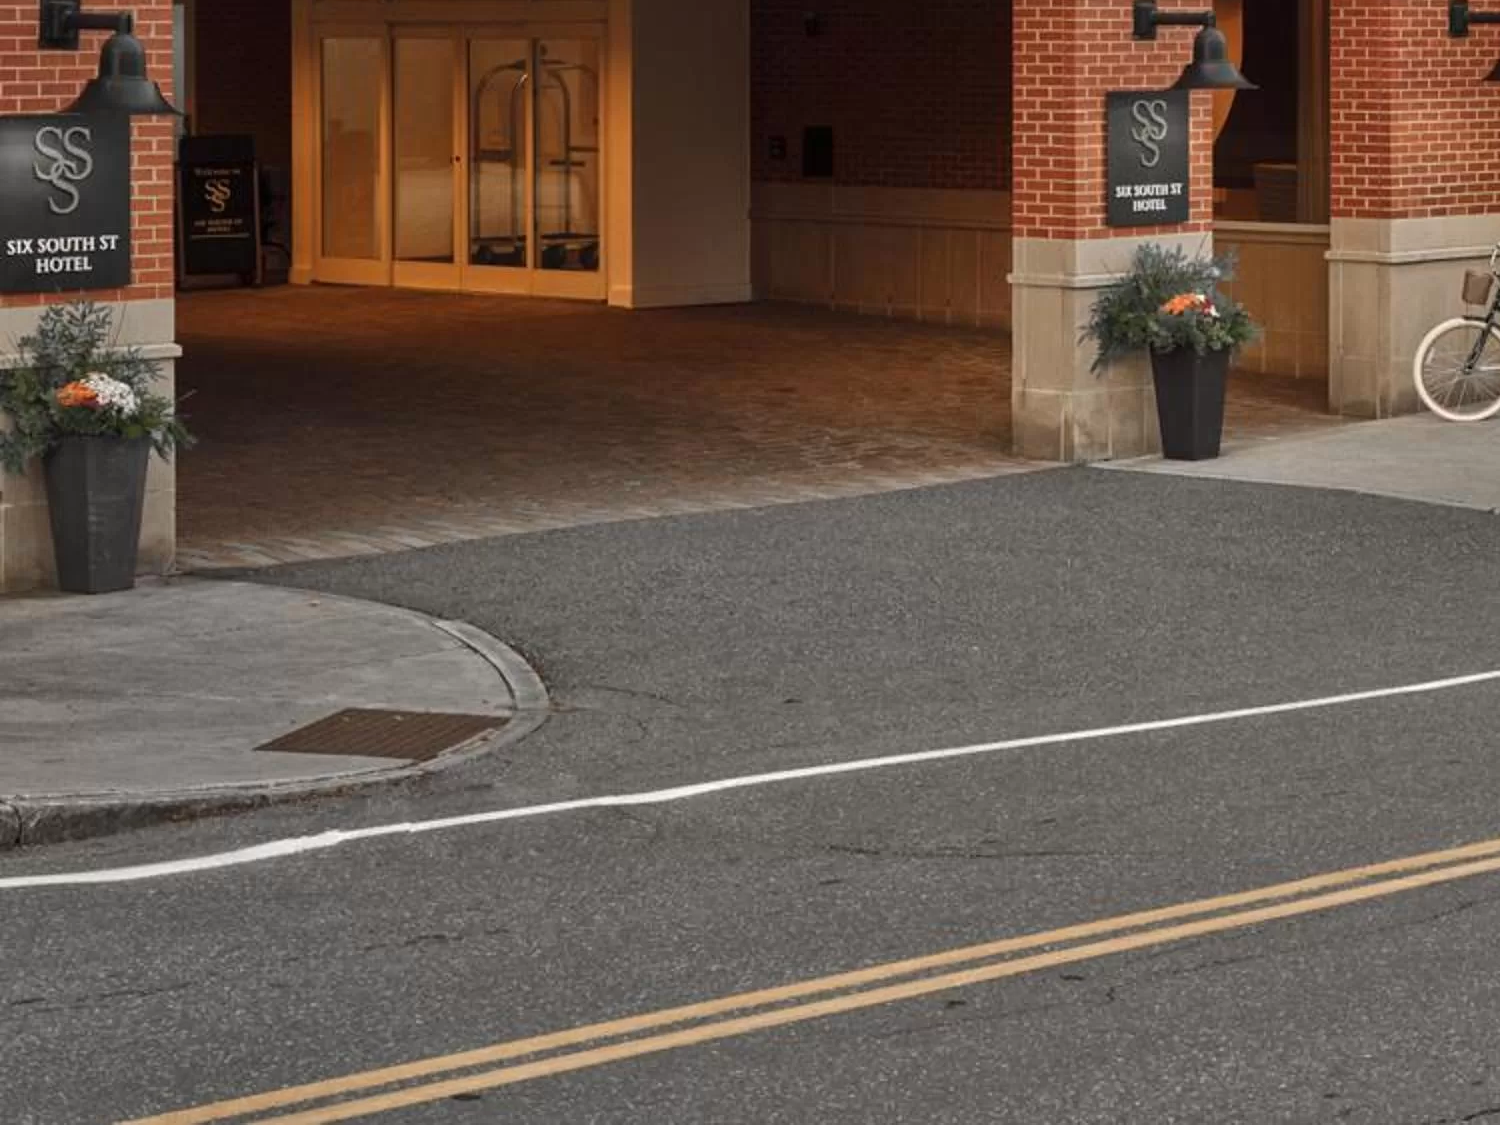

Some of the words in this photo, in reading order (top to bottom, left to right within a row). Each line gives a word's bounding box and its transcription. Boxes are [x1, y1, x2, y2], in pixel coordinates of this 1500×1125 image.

[1115, 185, 1132, 198] SIX
[1134, 184, 1169, 196] SOUTH
[1170, 182, 1183, 195] ST
[1133, 199, 1166, 212] HOTEL
[7, 239, 34, 255] SIX
[38, 236, 95, 253] SOUTH
[100, 234, 119, 251] ST
[36, 256, 92, 274] HOTEL
